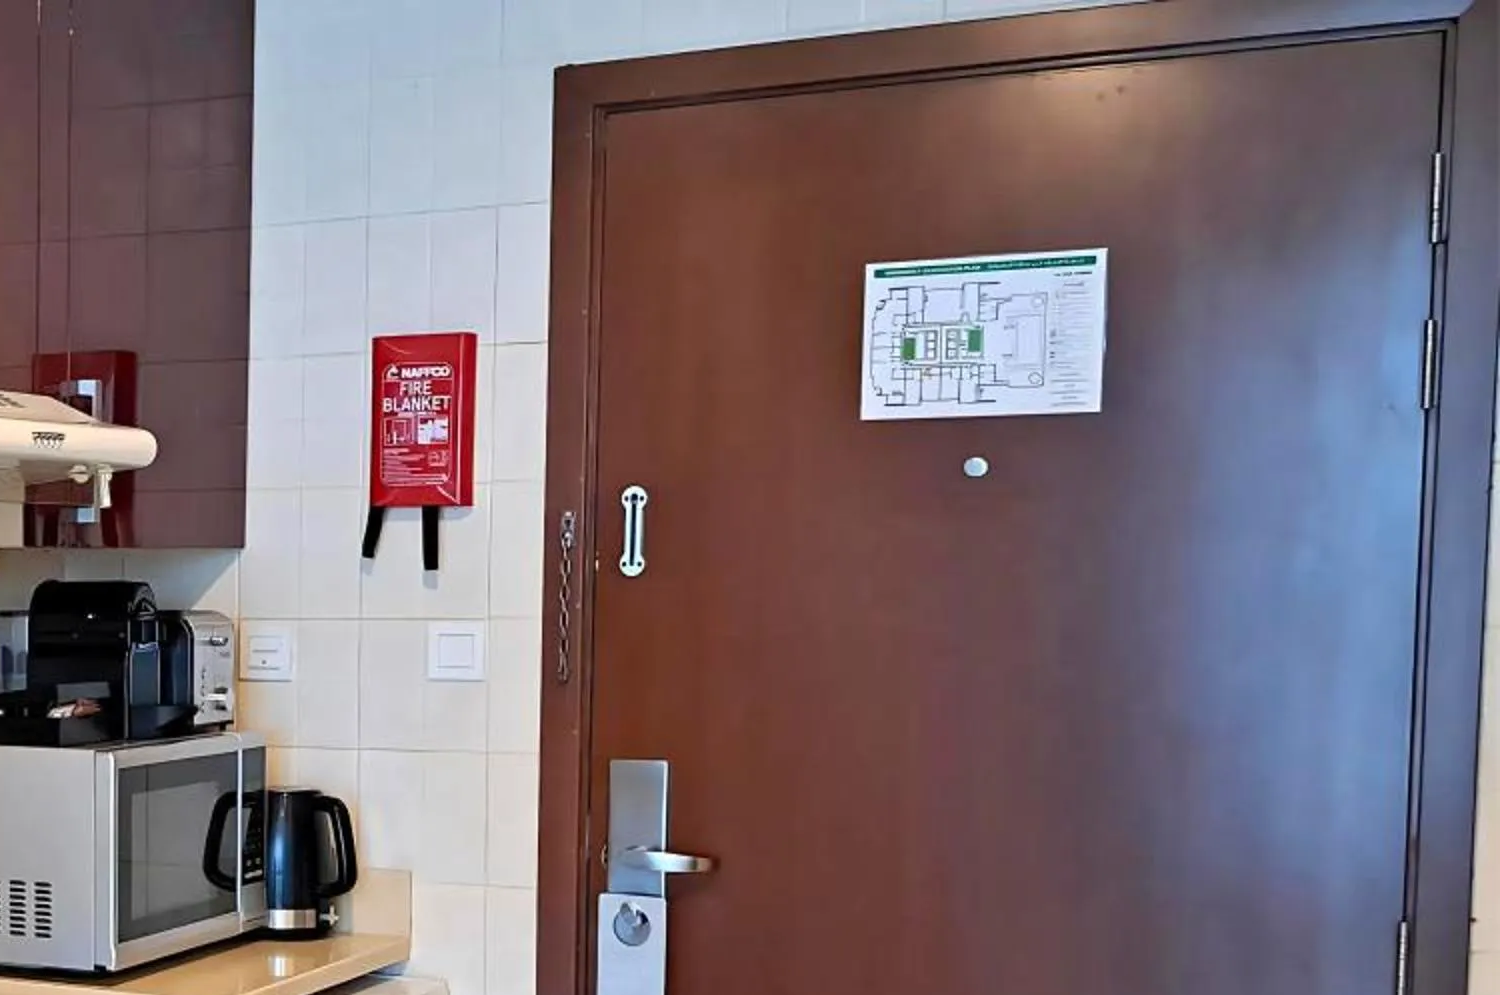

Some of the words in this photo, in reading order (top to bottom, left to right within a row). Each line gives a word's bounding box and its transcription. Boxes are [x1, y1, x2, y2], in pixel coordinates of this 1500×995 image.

[401, 366, 450, 378] NAFFCO
[399, 380, 432, 396] FIRE
[382, 395, 451, 412] BLANKET
